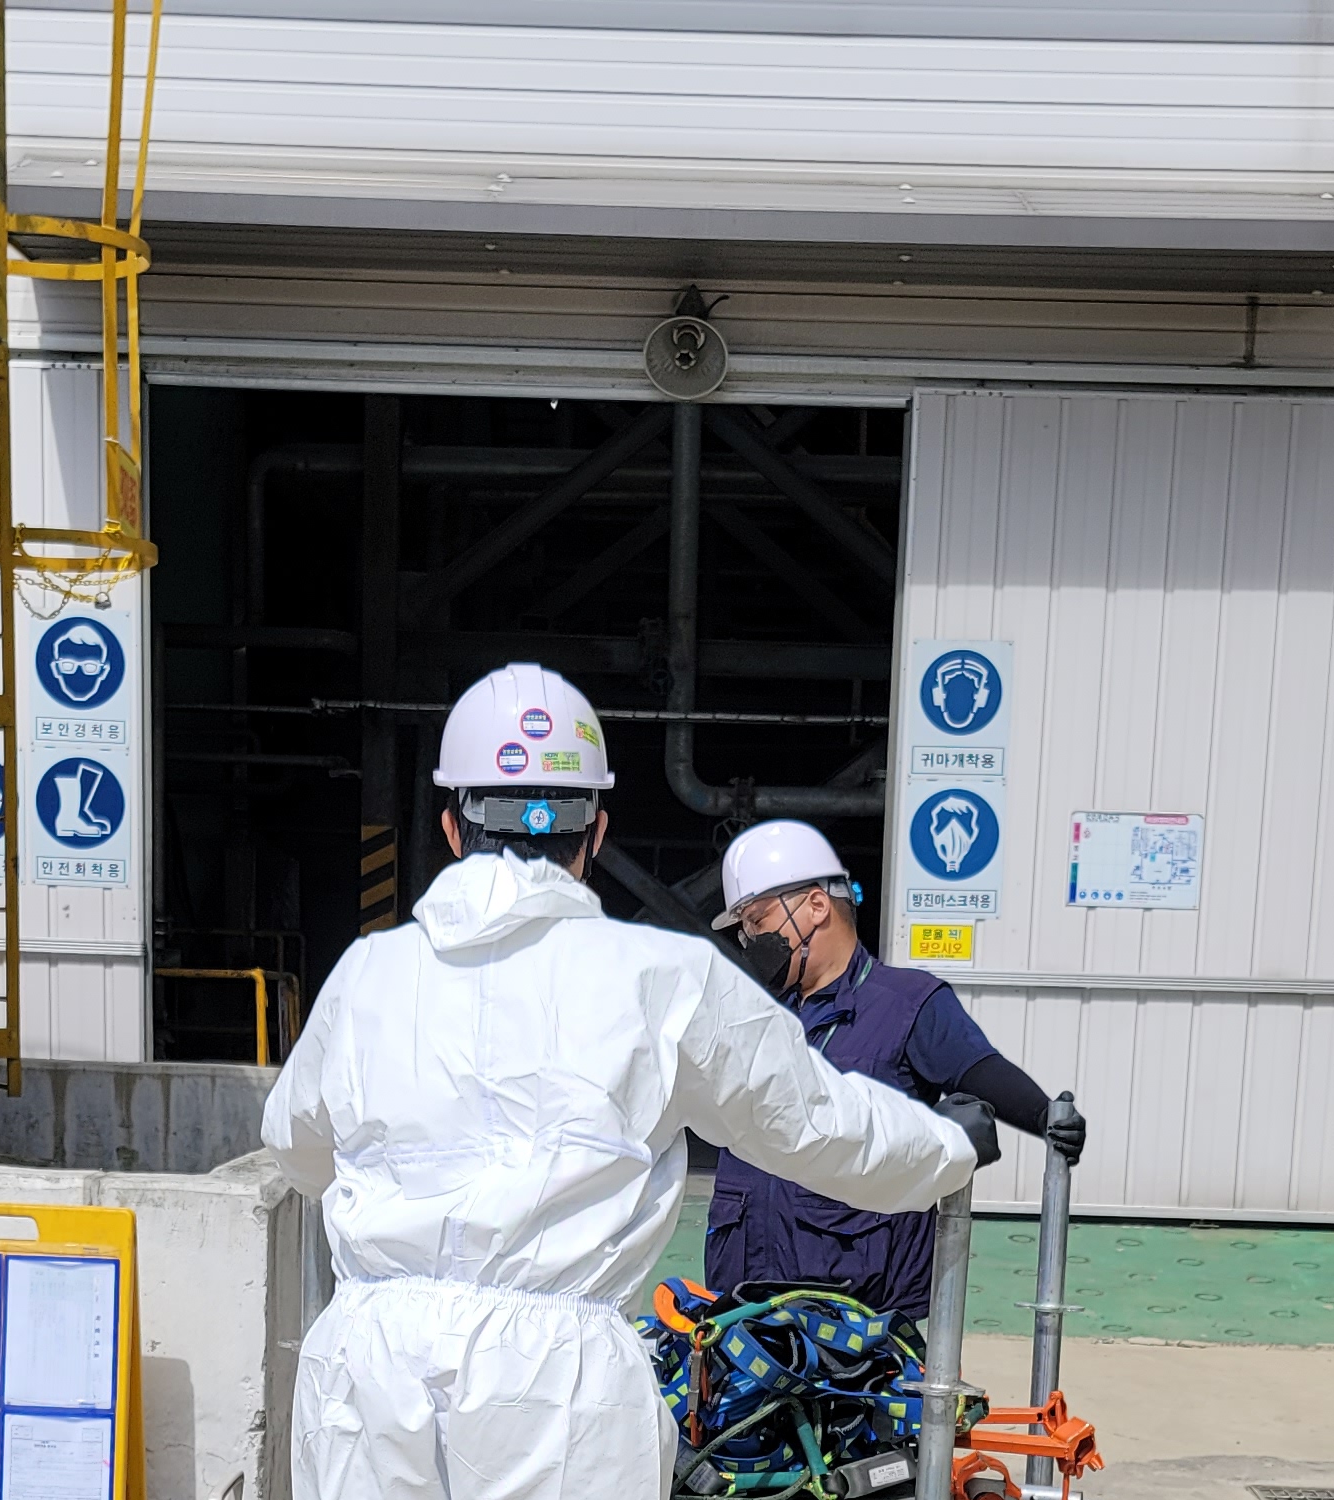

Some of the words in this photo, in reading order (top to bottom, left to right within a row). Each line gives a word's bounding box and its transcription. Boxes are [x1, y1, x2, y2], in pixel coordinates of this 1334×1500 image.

[921, 753, 995, 768] 귀마개착용
[42, 861, 120, 878] 안전화착용
[912, 893, 991, 909] 방진마스크착용
